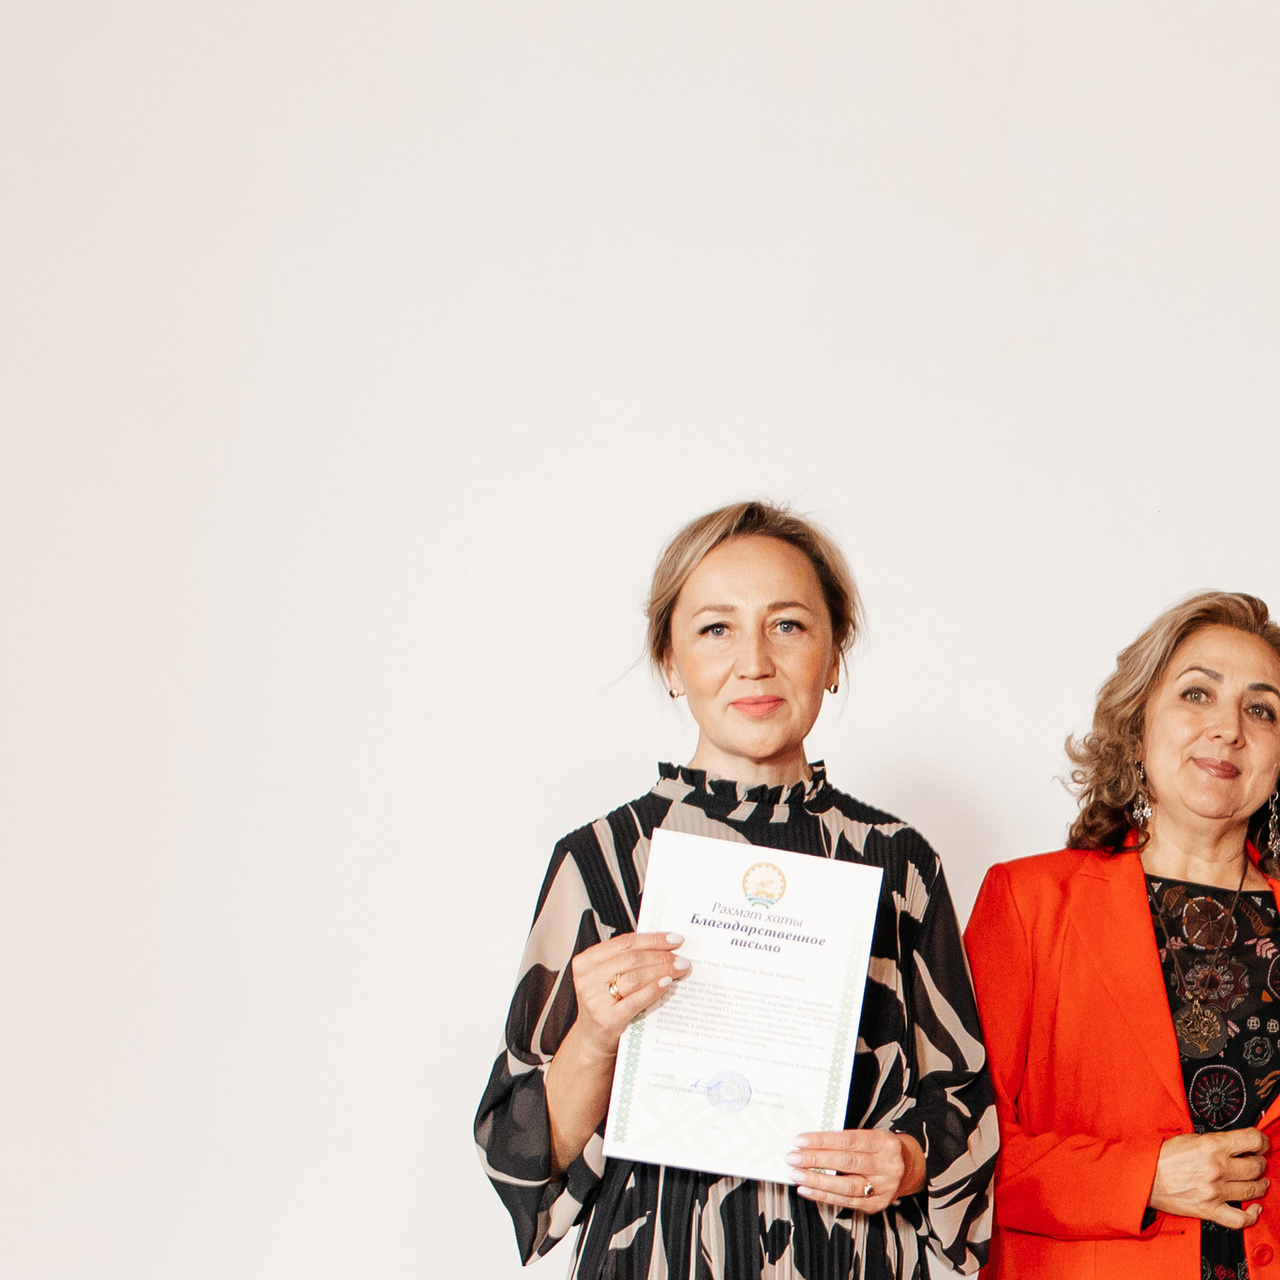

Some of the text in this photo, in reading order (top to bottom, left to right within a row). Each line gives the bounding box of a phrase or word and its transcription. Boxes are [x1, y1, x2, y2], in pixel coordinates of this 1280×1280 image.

[712, 902, 803, 928] Рәхмәт хаты
[690, 913, 827, 947] Благодарственное
[730, 937, 782, 954] письмо
